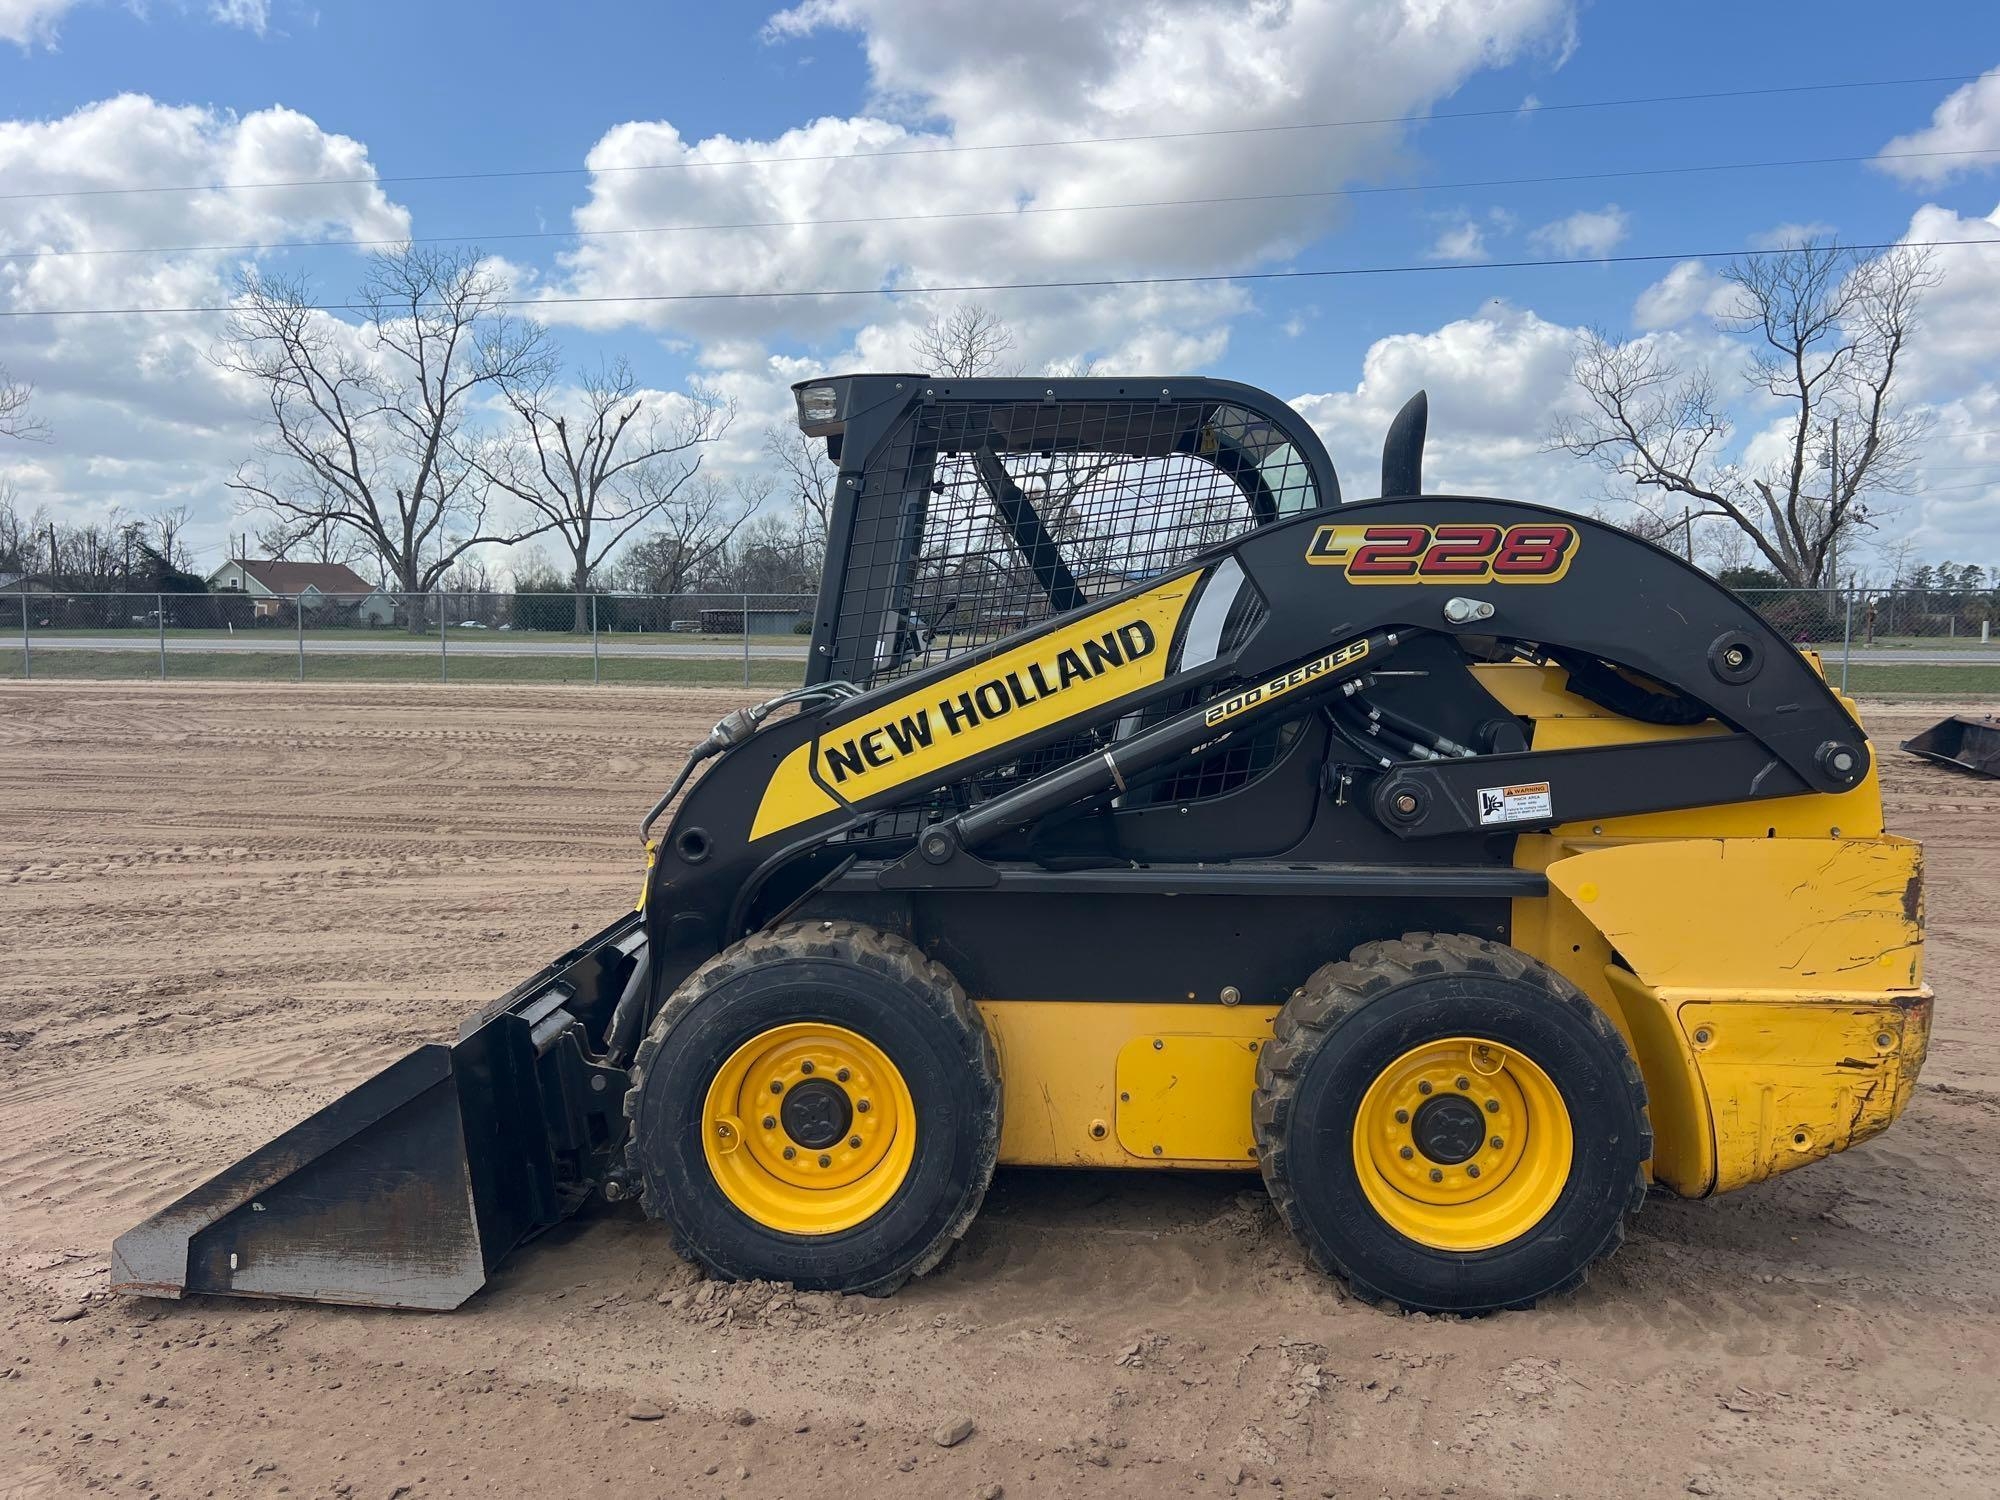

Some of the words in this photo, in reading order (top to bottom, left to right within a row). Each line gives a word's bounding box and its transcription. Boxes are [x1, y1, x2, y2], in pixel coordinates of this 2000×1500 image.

[1307, 527, 1575, 577] L228
[824, 708, 935, 783] NEW
[938, 619, 1156, 736] HOLLAND
[1207, 688, 1262, 723] 200
[1269, 641, 1367, 694] SERIES
[1514, 785, 1545, 794] WARNING
